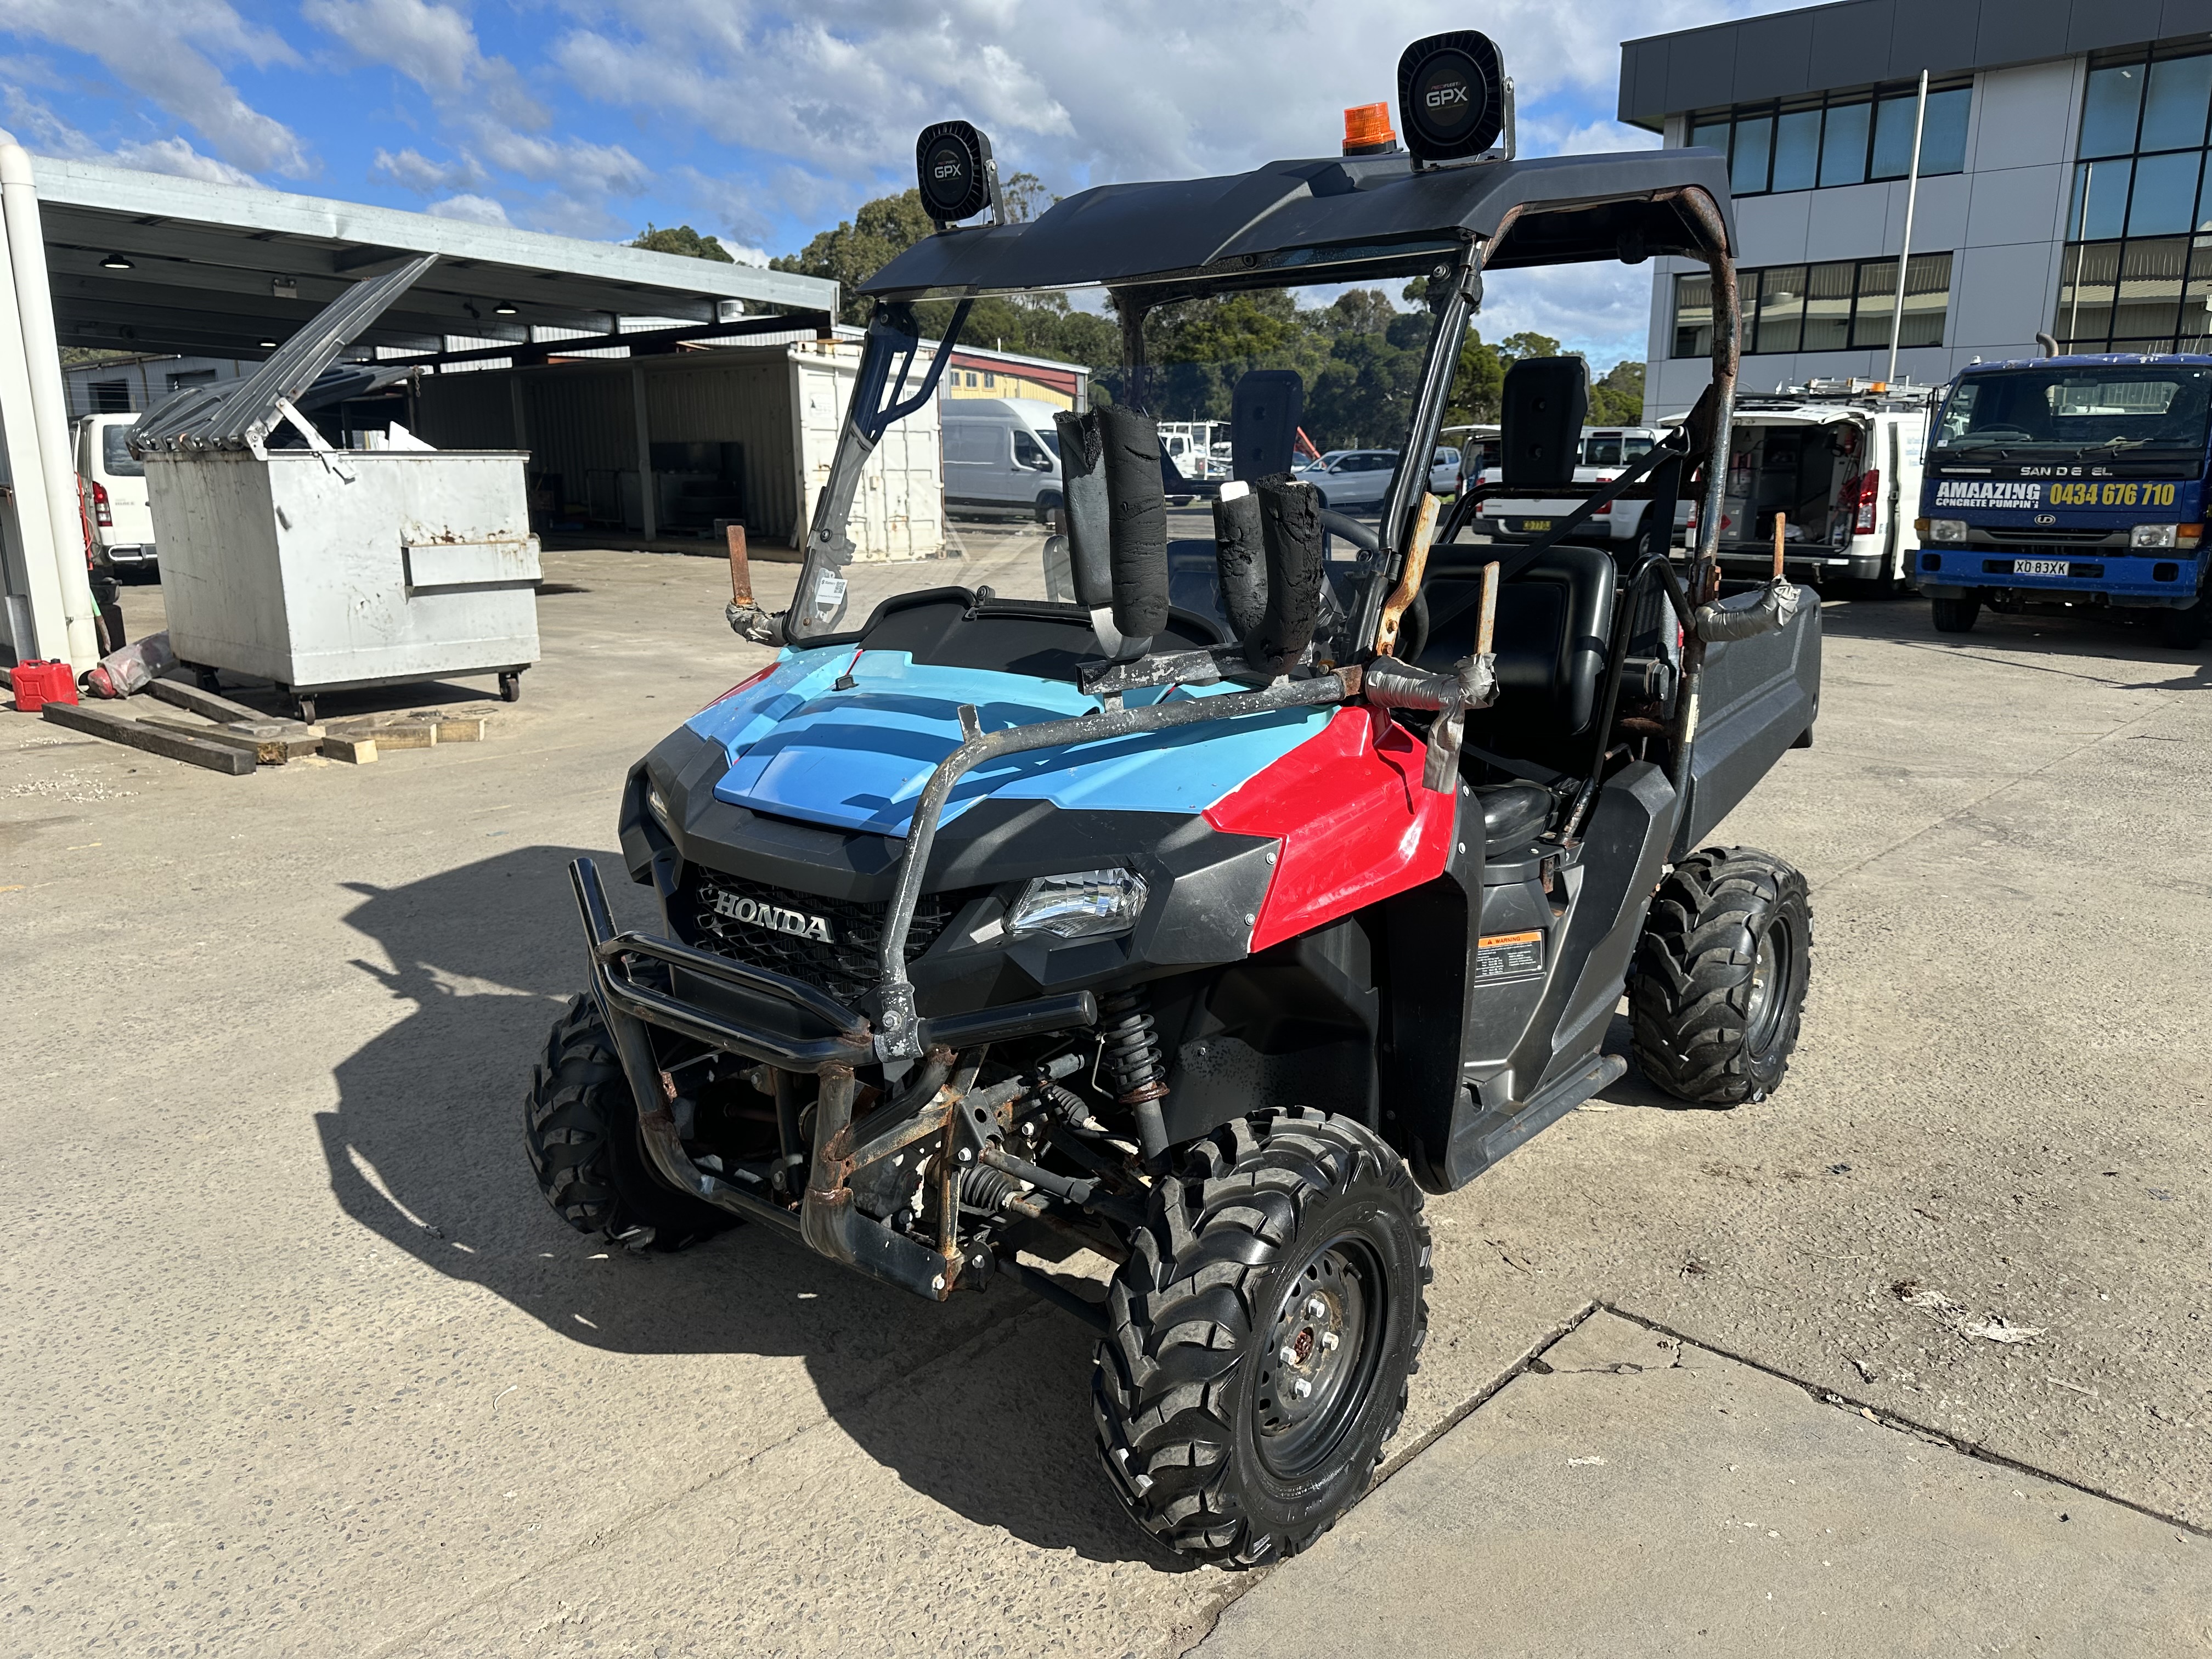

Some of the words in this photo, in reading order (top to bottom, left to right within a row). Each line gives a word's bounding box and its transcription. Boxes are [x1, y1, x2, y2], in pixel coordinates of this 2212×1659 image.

[1426, 86, 1468, 107] GPX
[934, 163, 962, 178] GPX
[2020, 467, 2051, 476] SAN
[1937, 482, 2041, 500] AMAAZING
[2050, 483, 2098, 505] 0434
[2102, 483, 2138, 505] 676
[2141, 483, 2175, 505] 710
[1936, 498, 1987, 507] CONCRETE
[714, 890, 834, 944] HONDA
